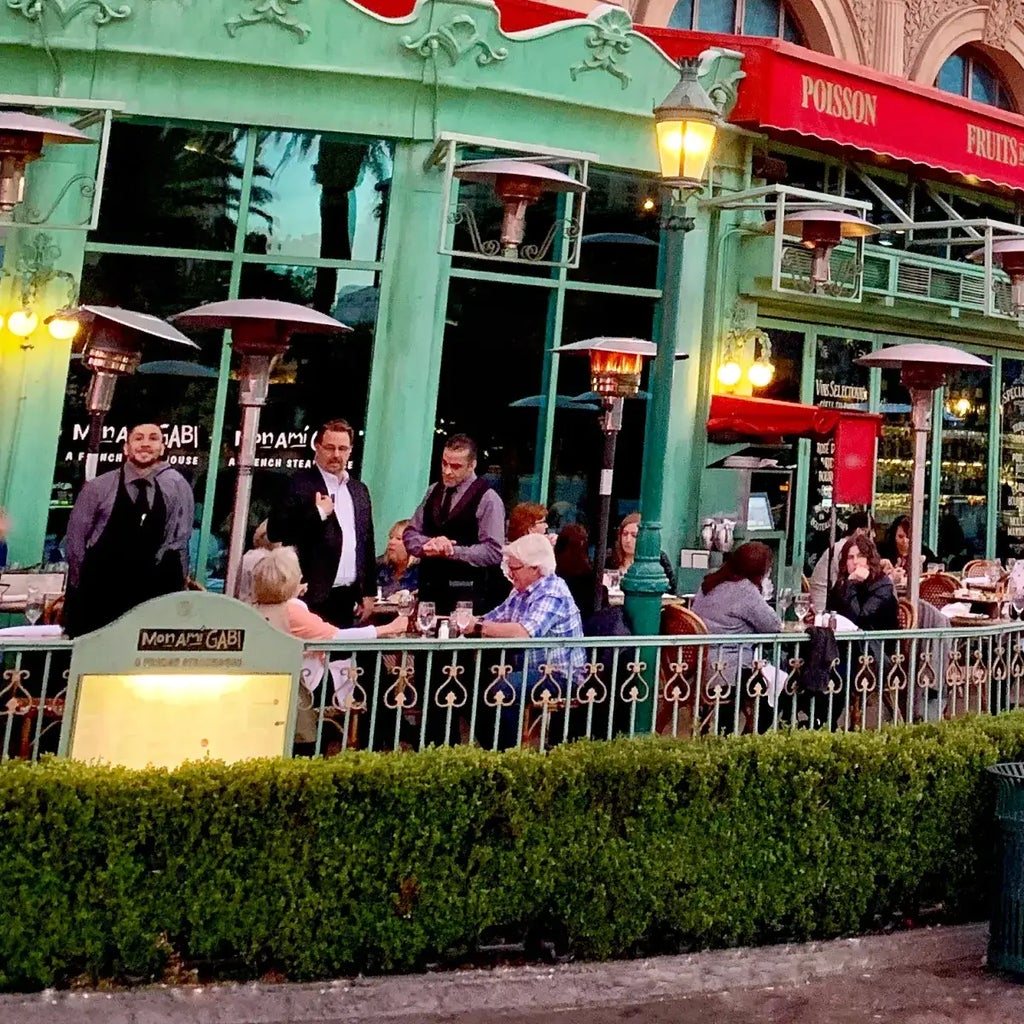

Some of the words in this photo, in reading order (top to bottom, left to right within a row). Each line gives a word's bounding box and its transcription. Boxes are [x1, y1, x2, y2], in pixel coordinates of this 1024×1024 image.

[801, 74, 877, 127] POISSON
[966, 123, 1018, 167] FRUITS
[72, 424, 115, 443] Mn
[65, 452, 74, 462] A
[78, 452, 123, 463] FNCH
[254, 458, 282, 467] ENCH
[141, 631, 175, 647] Mon
[205, 629, 241, 650] GABI
